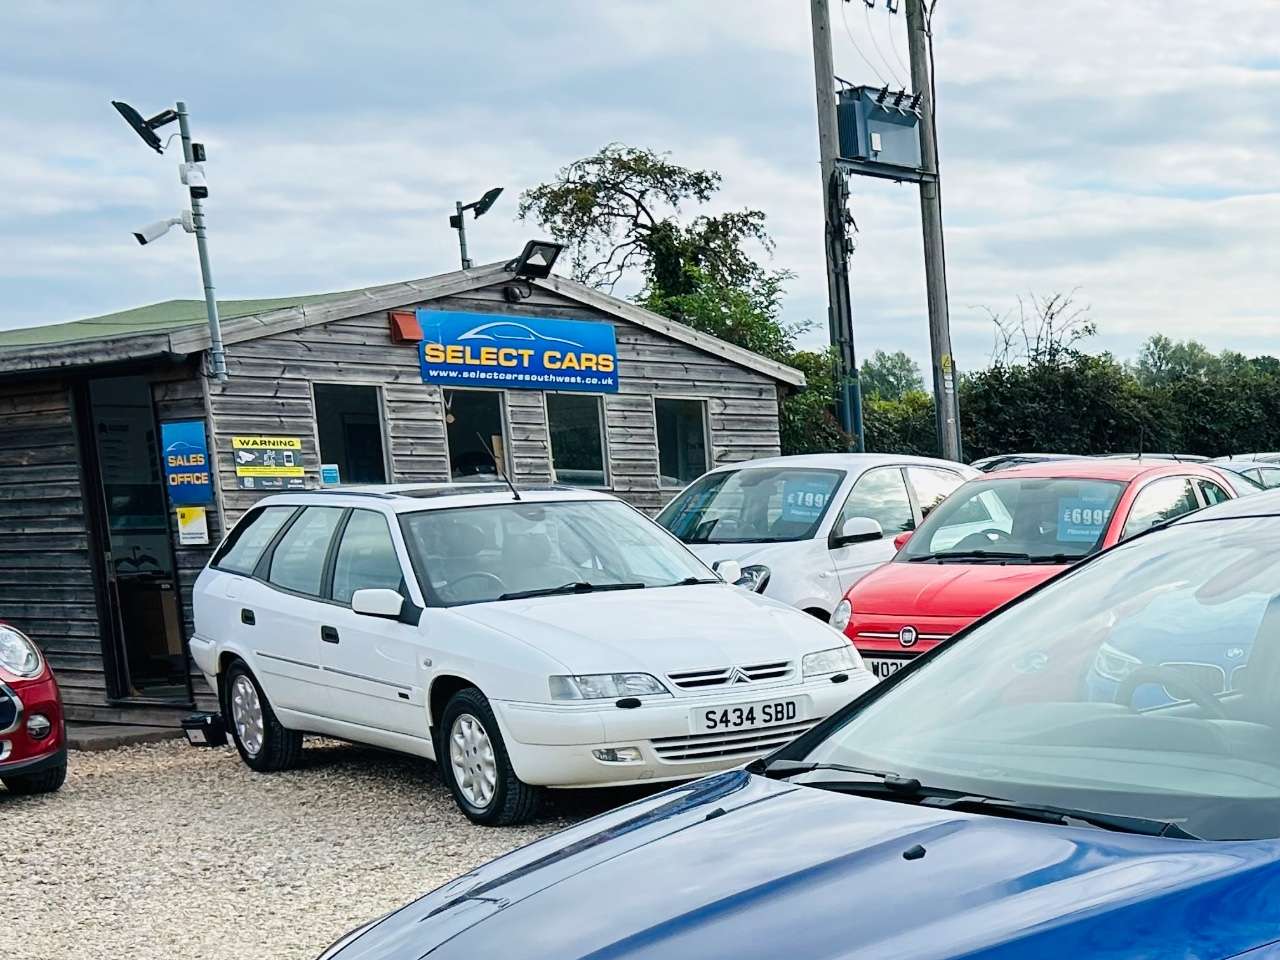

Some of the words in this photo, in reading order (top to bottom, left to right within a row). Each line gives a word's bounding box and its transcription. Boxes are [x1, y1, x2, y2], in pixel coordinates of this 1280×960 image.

[424, 343, 534, 368] SELECT
[543, 351, 615, 372] CARS
[429, 369, 614, 385] www.selectcarssouthwest.co.uk
[239, 439, 295, 447] WARNING
[168, 454, 205, 467] SALES
[169, 473, 209, 486] OFFICE
[705, 708, 756, 729] S434
[762, 701, 796, 723] SBD
